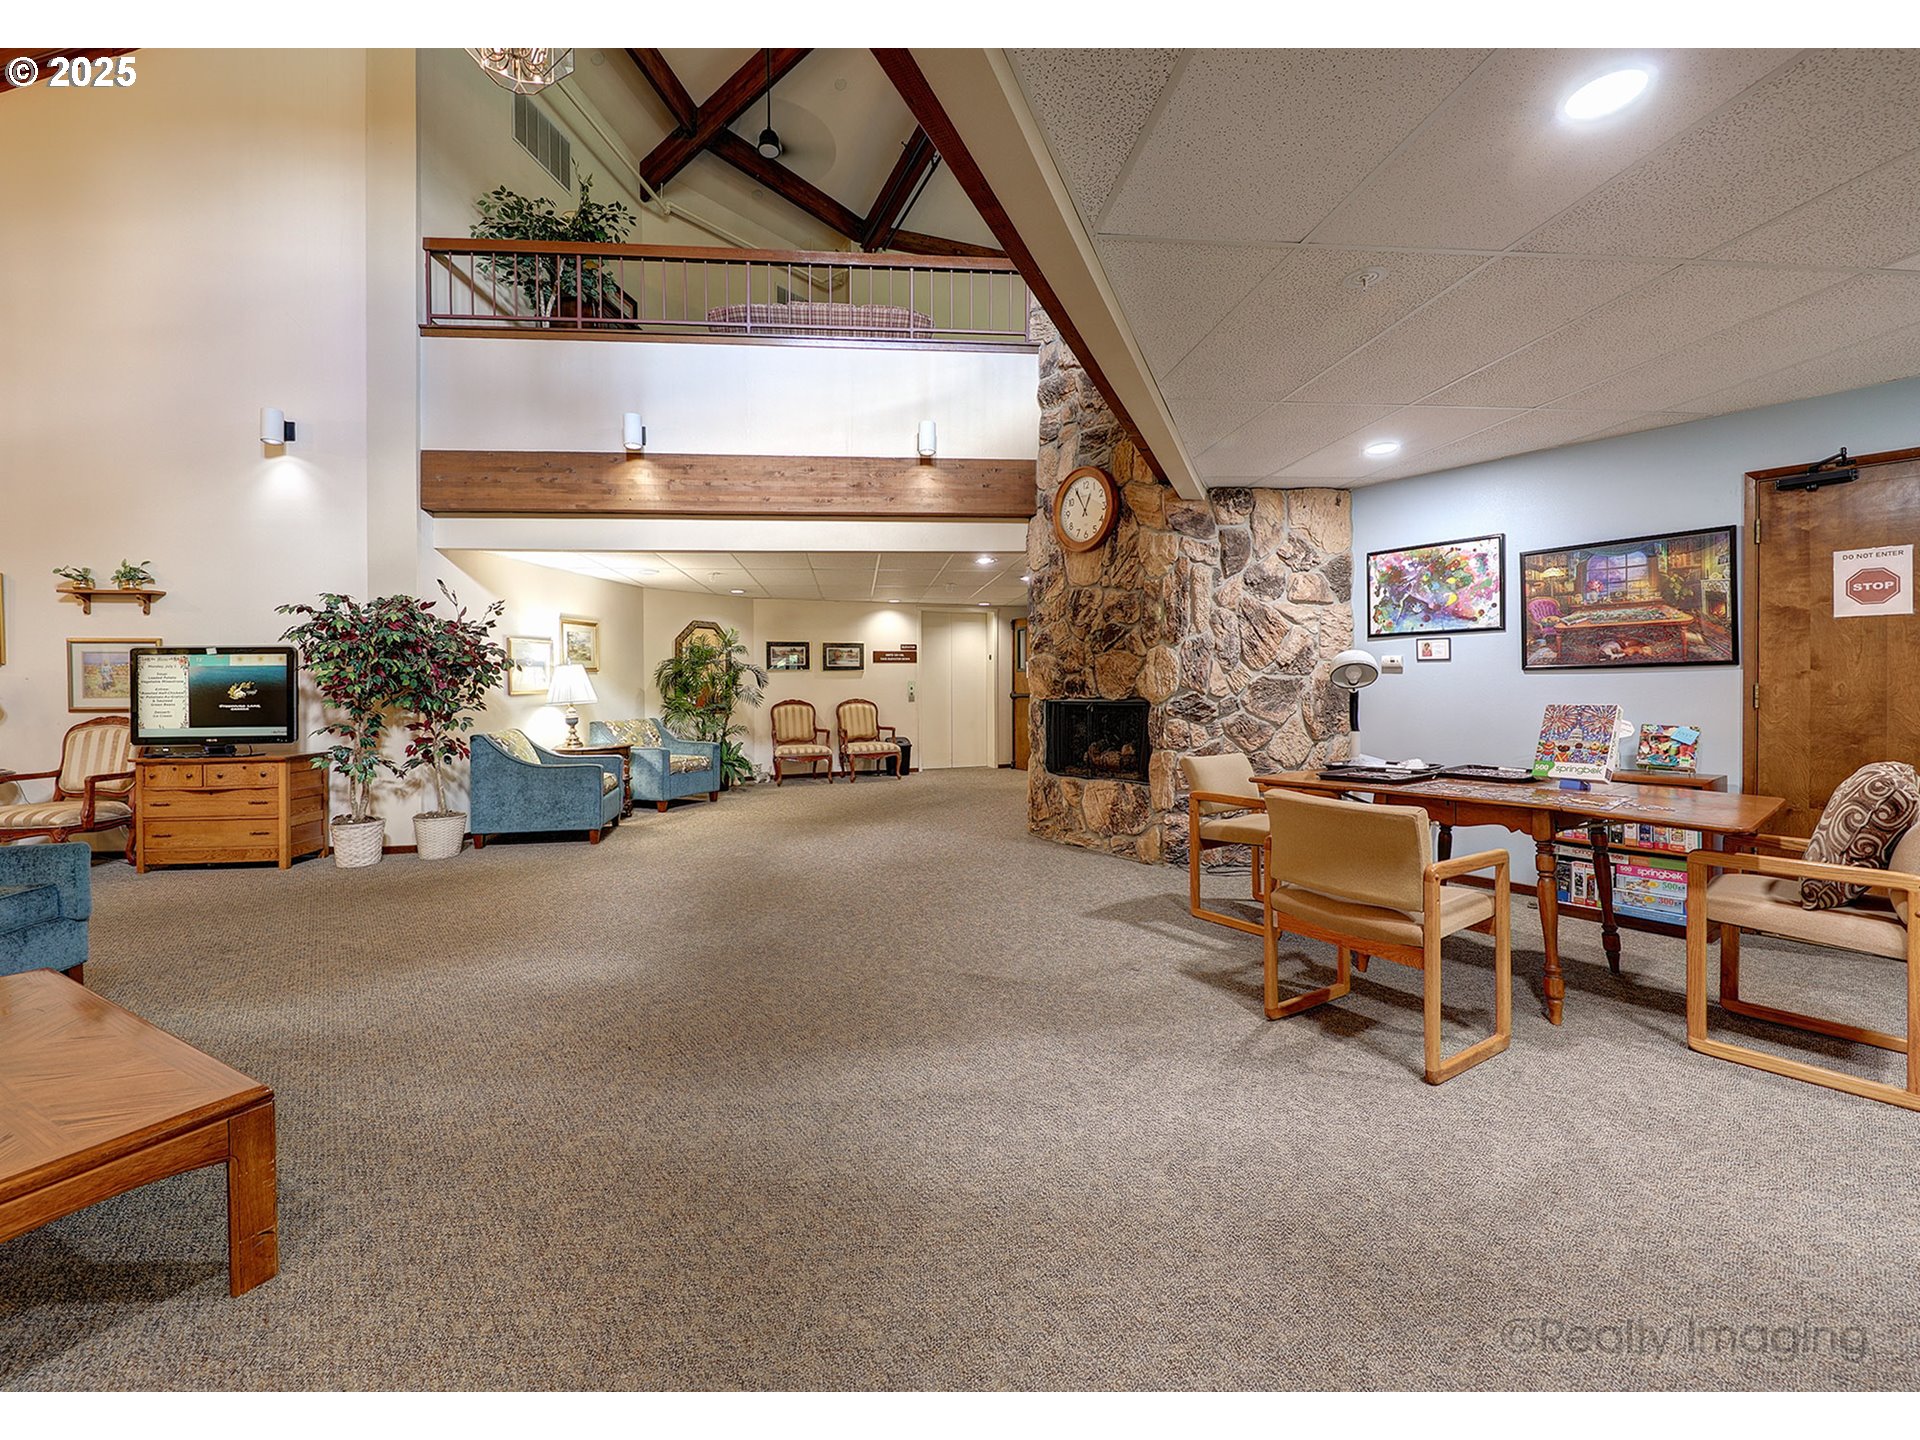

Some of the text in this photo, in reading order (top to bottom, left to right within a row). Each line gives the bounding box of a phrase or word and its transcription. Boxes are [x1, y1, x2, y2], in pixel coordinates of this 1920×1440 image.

[1083, 481, 1089, 489] 12
[1099, 489, 1104, 497] 2
[1066, 510, 1071, 519] 9
[1069, 522, 1074, 530] 8
[1092, 525, 1097, 533] 5
[1076, 529, 1081, 537] 7
[1084, 530, 1089, 539] 6
[1875, 549, 1904, 558] ENTER
[1852, 581, 1895, 592] STOP
[1535, 763, 1549, 772] 500
[1571, 848, 1595, 857] spring
[1662, 881, 1678, 891] 500
[1658, 896, 1674, 906] 300
